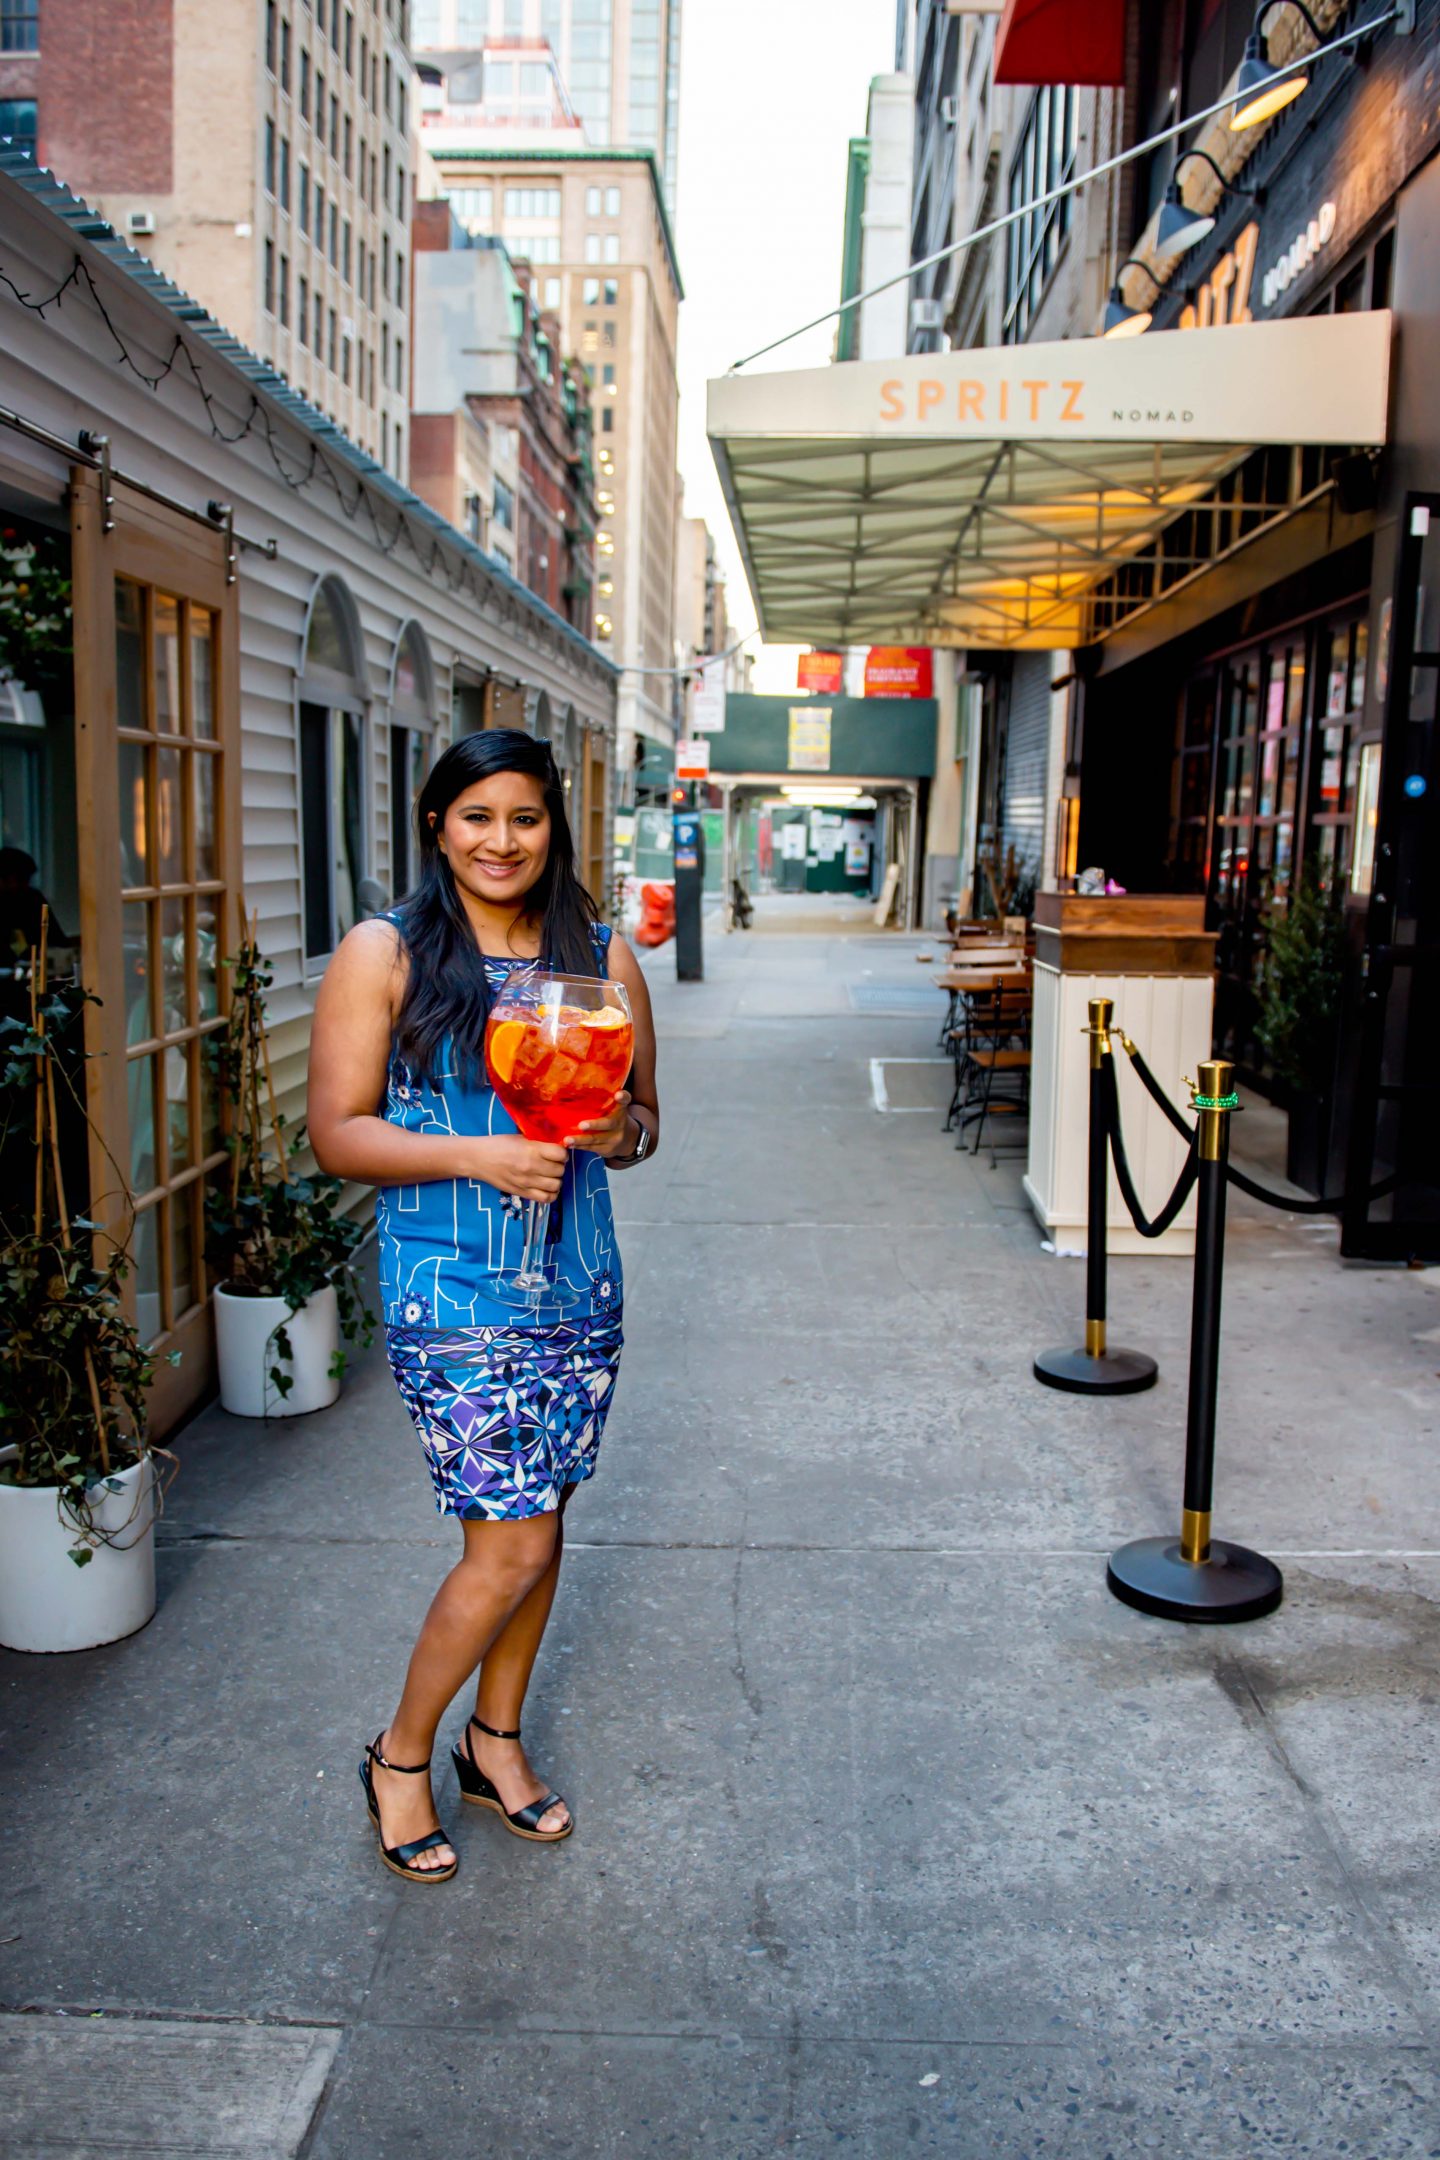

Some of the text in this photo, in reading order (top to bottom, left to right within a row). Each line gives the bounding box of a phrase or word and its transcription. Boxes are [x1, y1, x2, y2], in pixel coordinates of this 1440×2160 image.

[1262, 202, 1336, 306] NOMAD
[879, 379, 1194, 423] SPRITZ NOMAD
